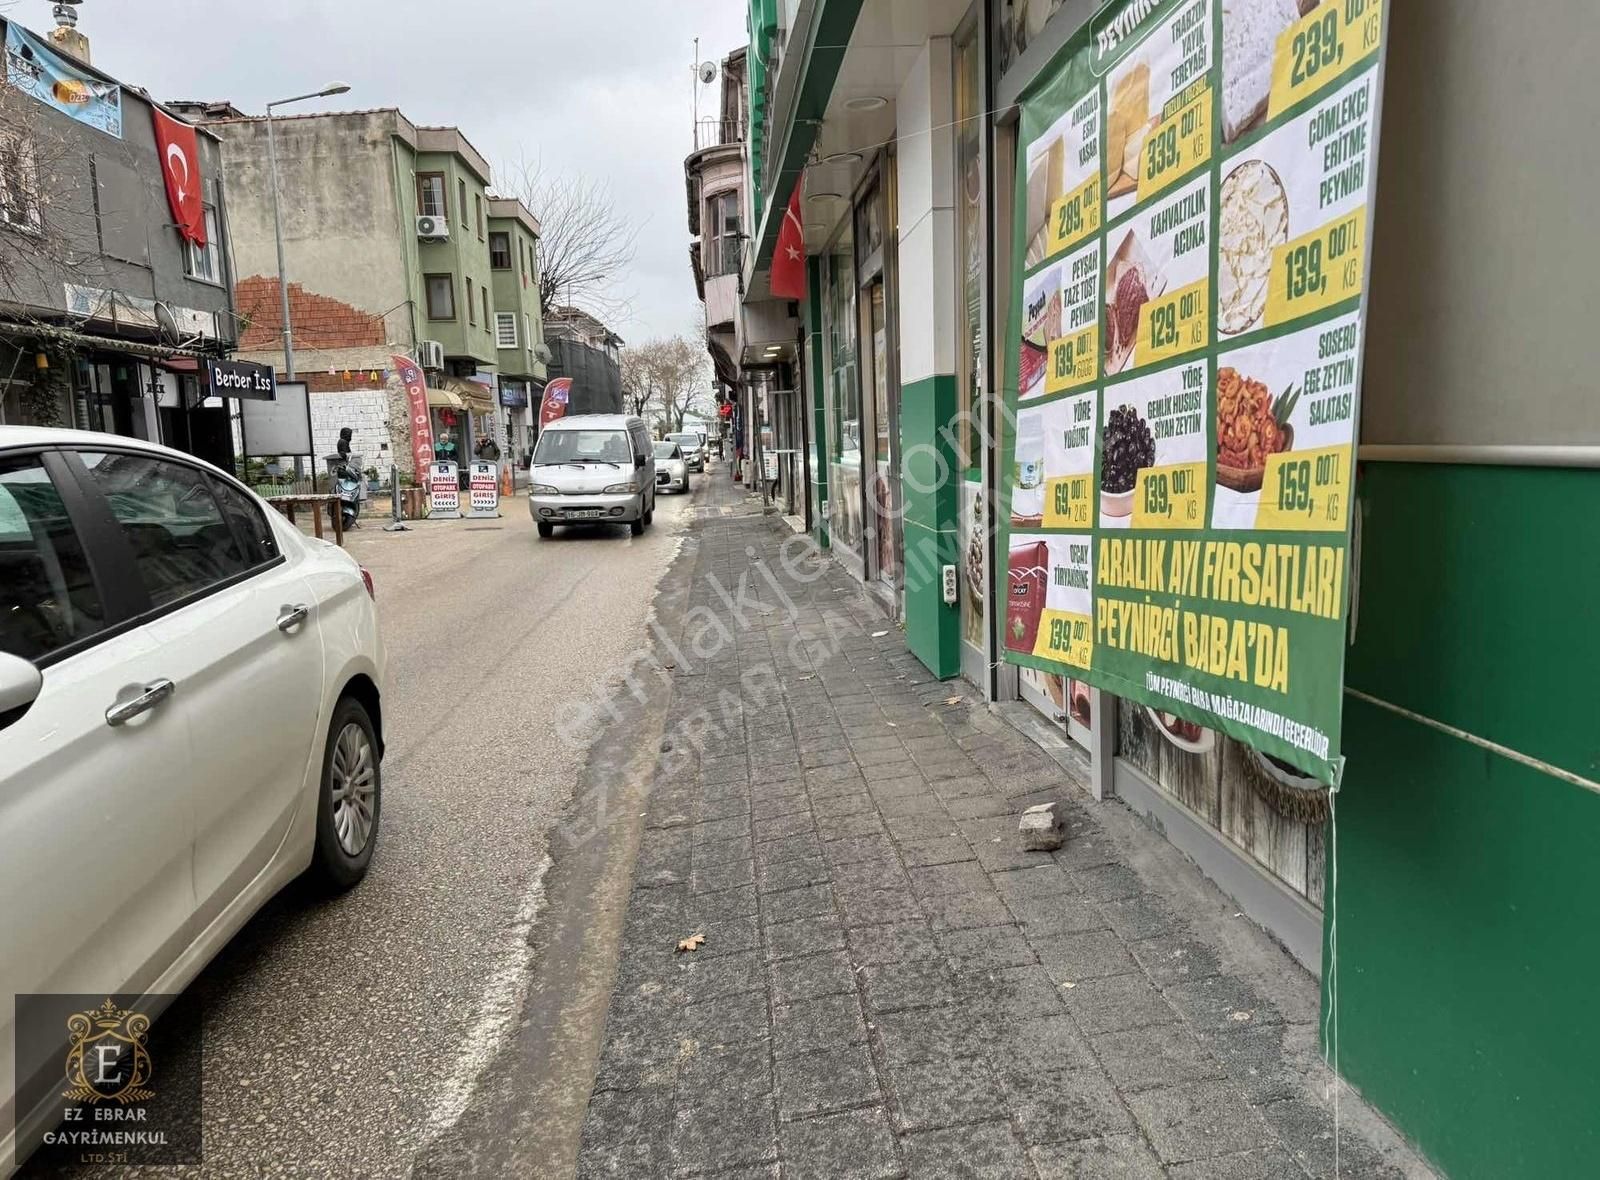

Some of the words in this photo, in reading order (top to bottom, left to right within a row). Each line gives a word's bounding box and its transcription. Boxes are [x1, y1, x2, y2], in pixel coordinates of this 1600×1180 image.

[1182, 21, 1205, 58] YAYIK
[1362, 13, 1378, 49] KG
[1071, 91, 1099, 129] ANADOLU
[1308, 78, 1370, 150] ÇÖMLEKÇİ
[1193, 133, 1204, 160] KG
[1323, 120, 1368, 173] ERİTME
[1319, 160, 1365, 209] PEYNİRİ
[1089, 207, 1098, 229] KG
[1150, 186, 1206, 240] KAHVALTILIK
[1173, 220, 1205, 258] ACUKA
[1342, 258, 1357, 290] KG
[1063, 284, 1080, 308] TAZE
[1080, 274, 1097, 301] TOST
[1070, 297, 1096, 329] PEYNİRİ
[1191, 321, 1202, 345] KG
[1319, 322, 1357, 359] SOSERO
[214, 367, 251, 388] Berber
[1181, 366, 1203, 390] YÖRE
[1303, 370, 1321, 396] EGE
[1321, 357, 1355, 392] ZEYTİN
[1073, 399, 1091, 423] YÖRE
[1147, 394, 1173, 419] GEMLİK
[1173, 388, 1202, 415] HUSUSİ
[1309, 393, 1353, 426] SALATASI
[1063, 426, 1090, 449] YOĞURT
[1154, 418, 1174, 440] SİYAH
[1175, 411, 1202, 435] ZEYTİN
[434, 492, 456, 500] GİRİŞ
[473, 491, 494, 499] GİRİŞ
[1187, 499, 1197, 520] KG
[1326, 494, 1339, 521] KG
[1074, 504, 1080, 522] 2
[1080, 503, 1088, 522] KG
[1097, 538, 1167, 592] ARALIK
[1168, 540, 1201, 597] AYI
[1201, 541, 1345, 620] FIRSATLARI
[1097, 595, 1180, 664] PEYNİRCİ
[1079, 647, 1088, 664] KG
[1145, 671, 1160, 693] TÜM
[1160, 677, 1192, 704] PEYNİRCİ
[1191, 687, 1212, 712] BABA
[1211, 694, 1285, 739] MAĞAZALARINDA
[1284, 718, 1329, 761] GEÇERLİDİR
